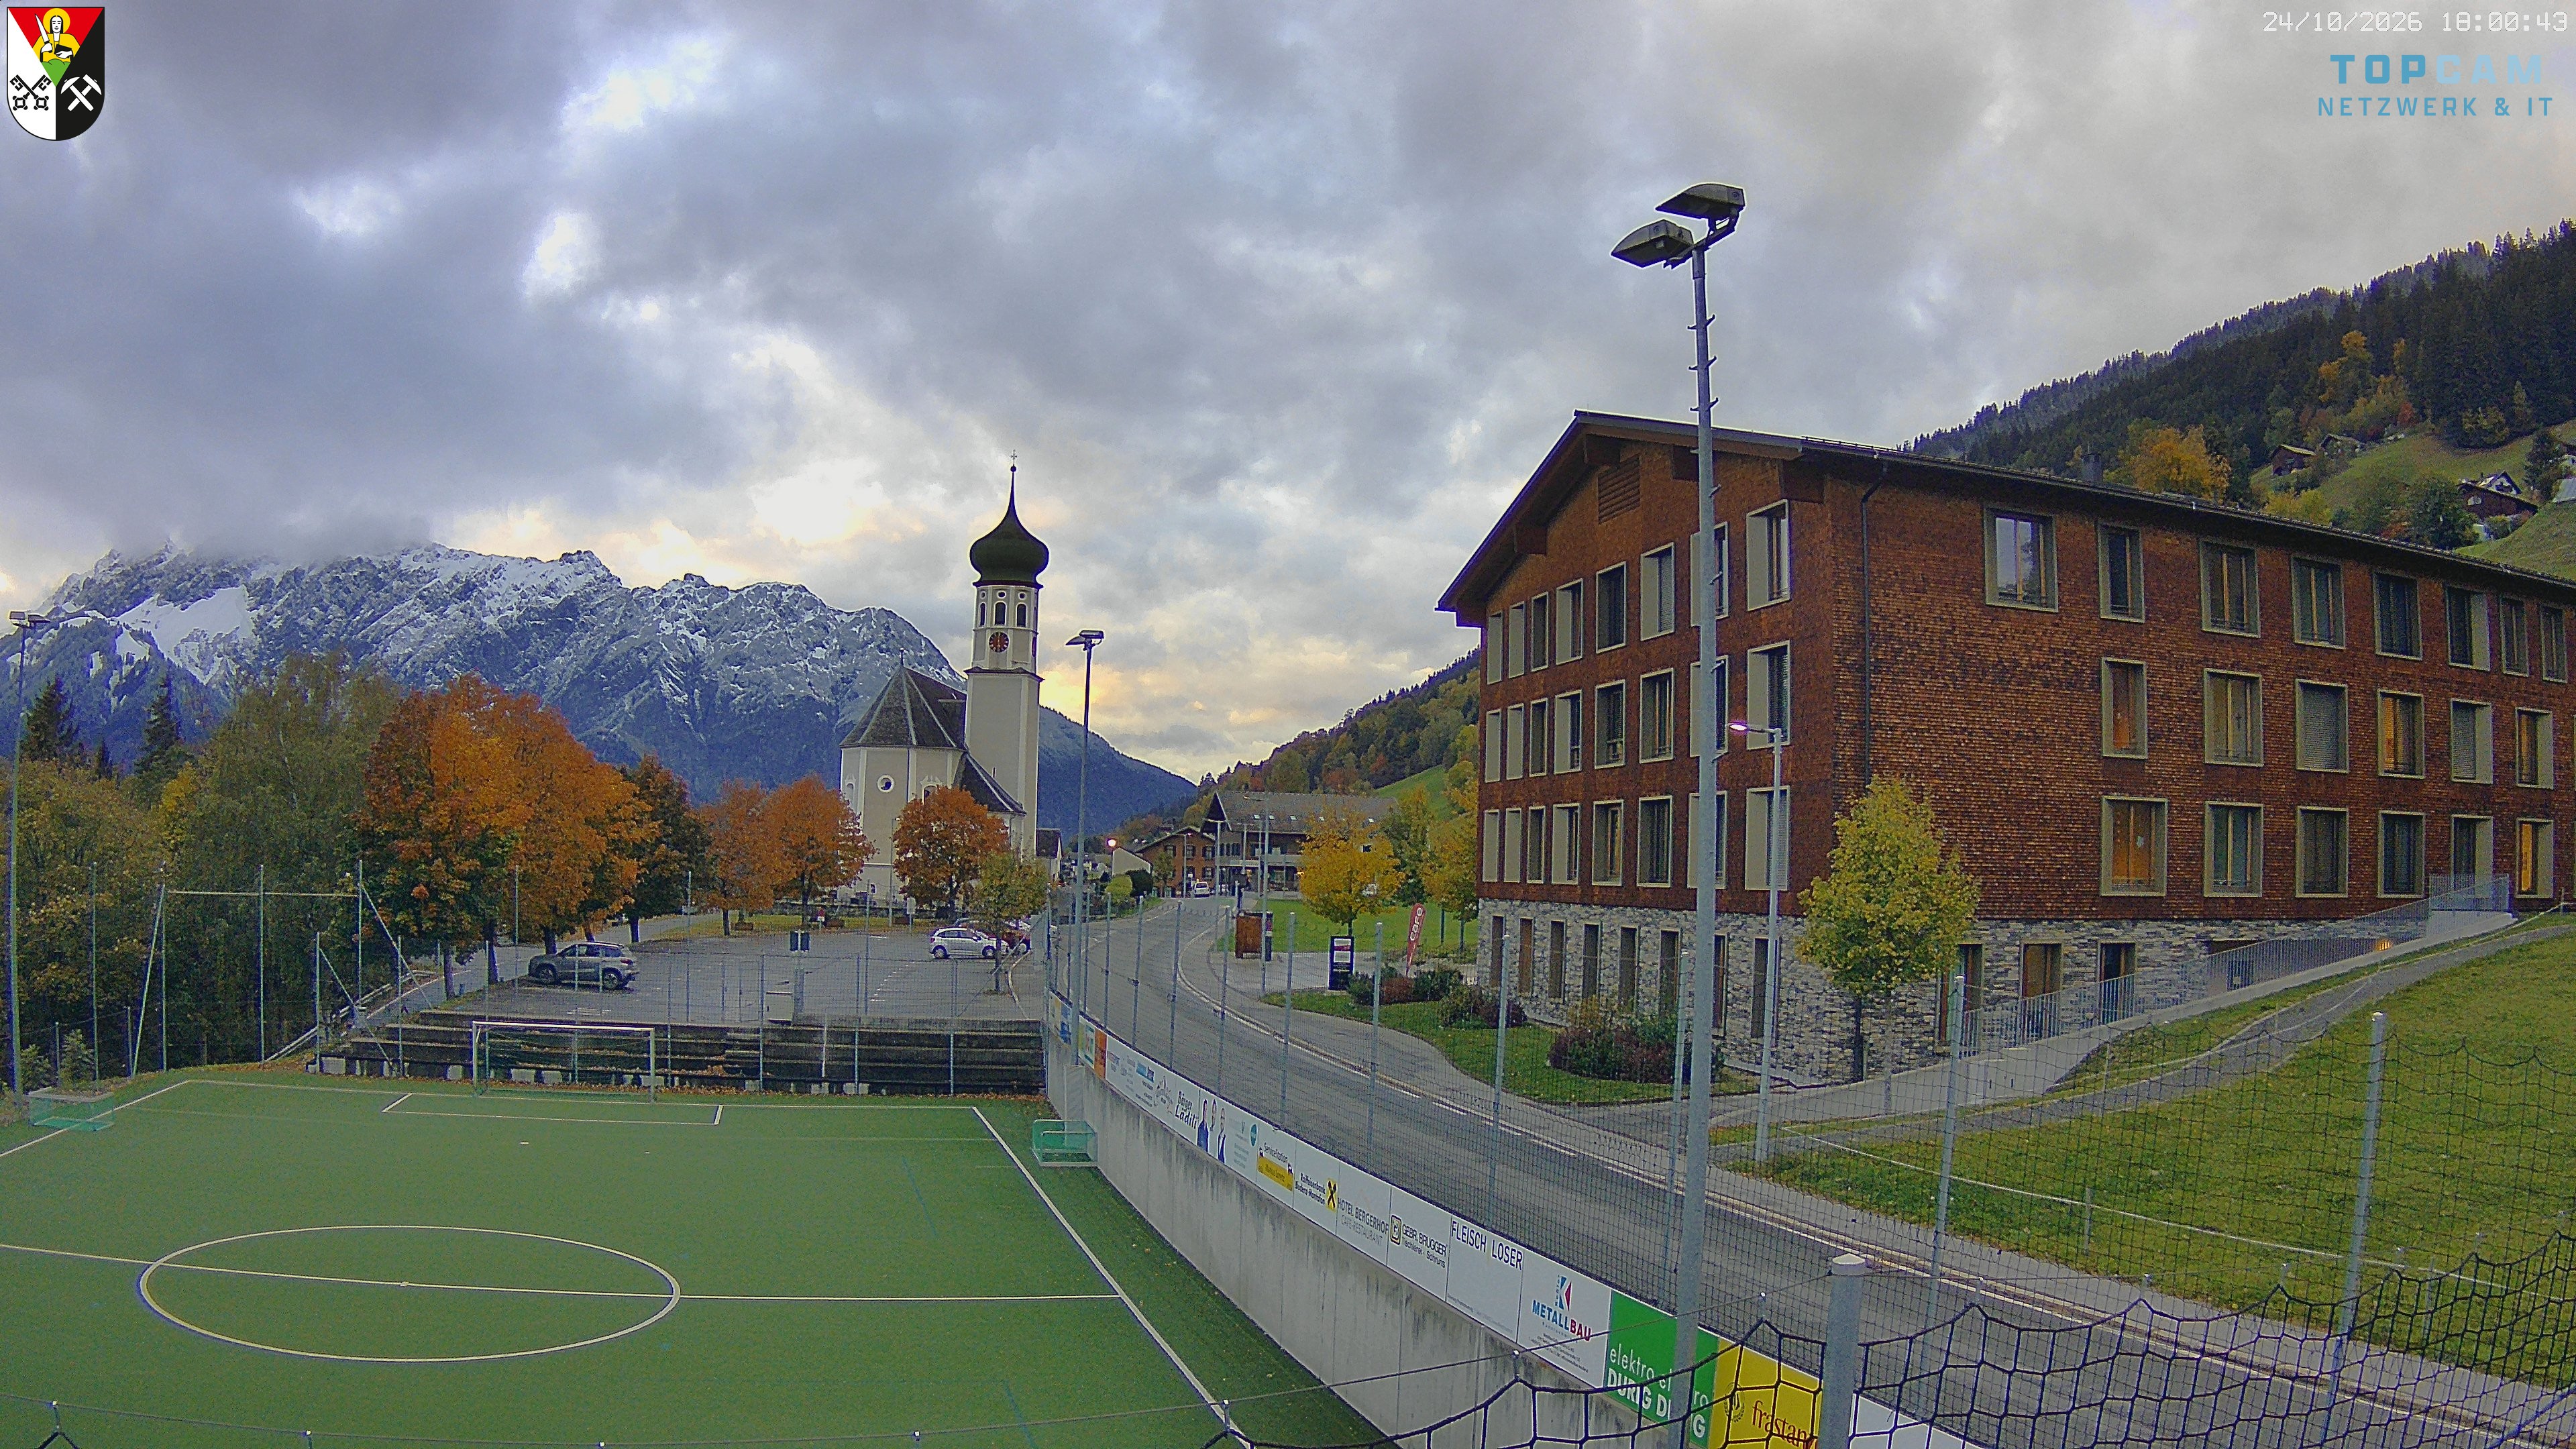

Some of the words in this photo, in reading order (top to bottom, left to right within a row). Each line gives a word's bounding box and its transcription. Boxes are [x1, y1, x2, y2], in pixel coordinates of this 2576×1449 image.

[1338, 1198, 1354, 1216] HOTEL
[1355, 1207, 1389, 1235] BERGERHOF
[1451, 1220, 1487, 1253] FLEISCH
[1491, 1239, 1523, 1271] LOSER
[1532, 1299, 1592, 1342] METALLBAU
[1609, 1343, 1655, 1381] elektro
